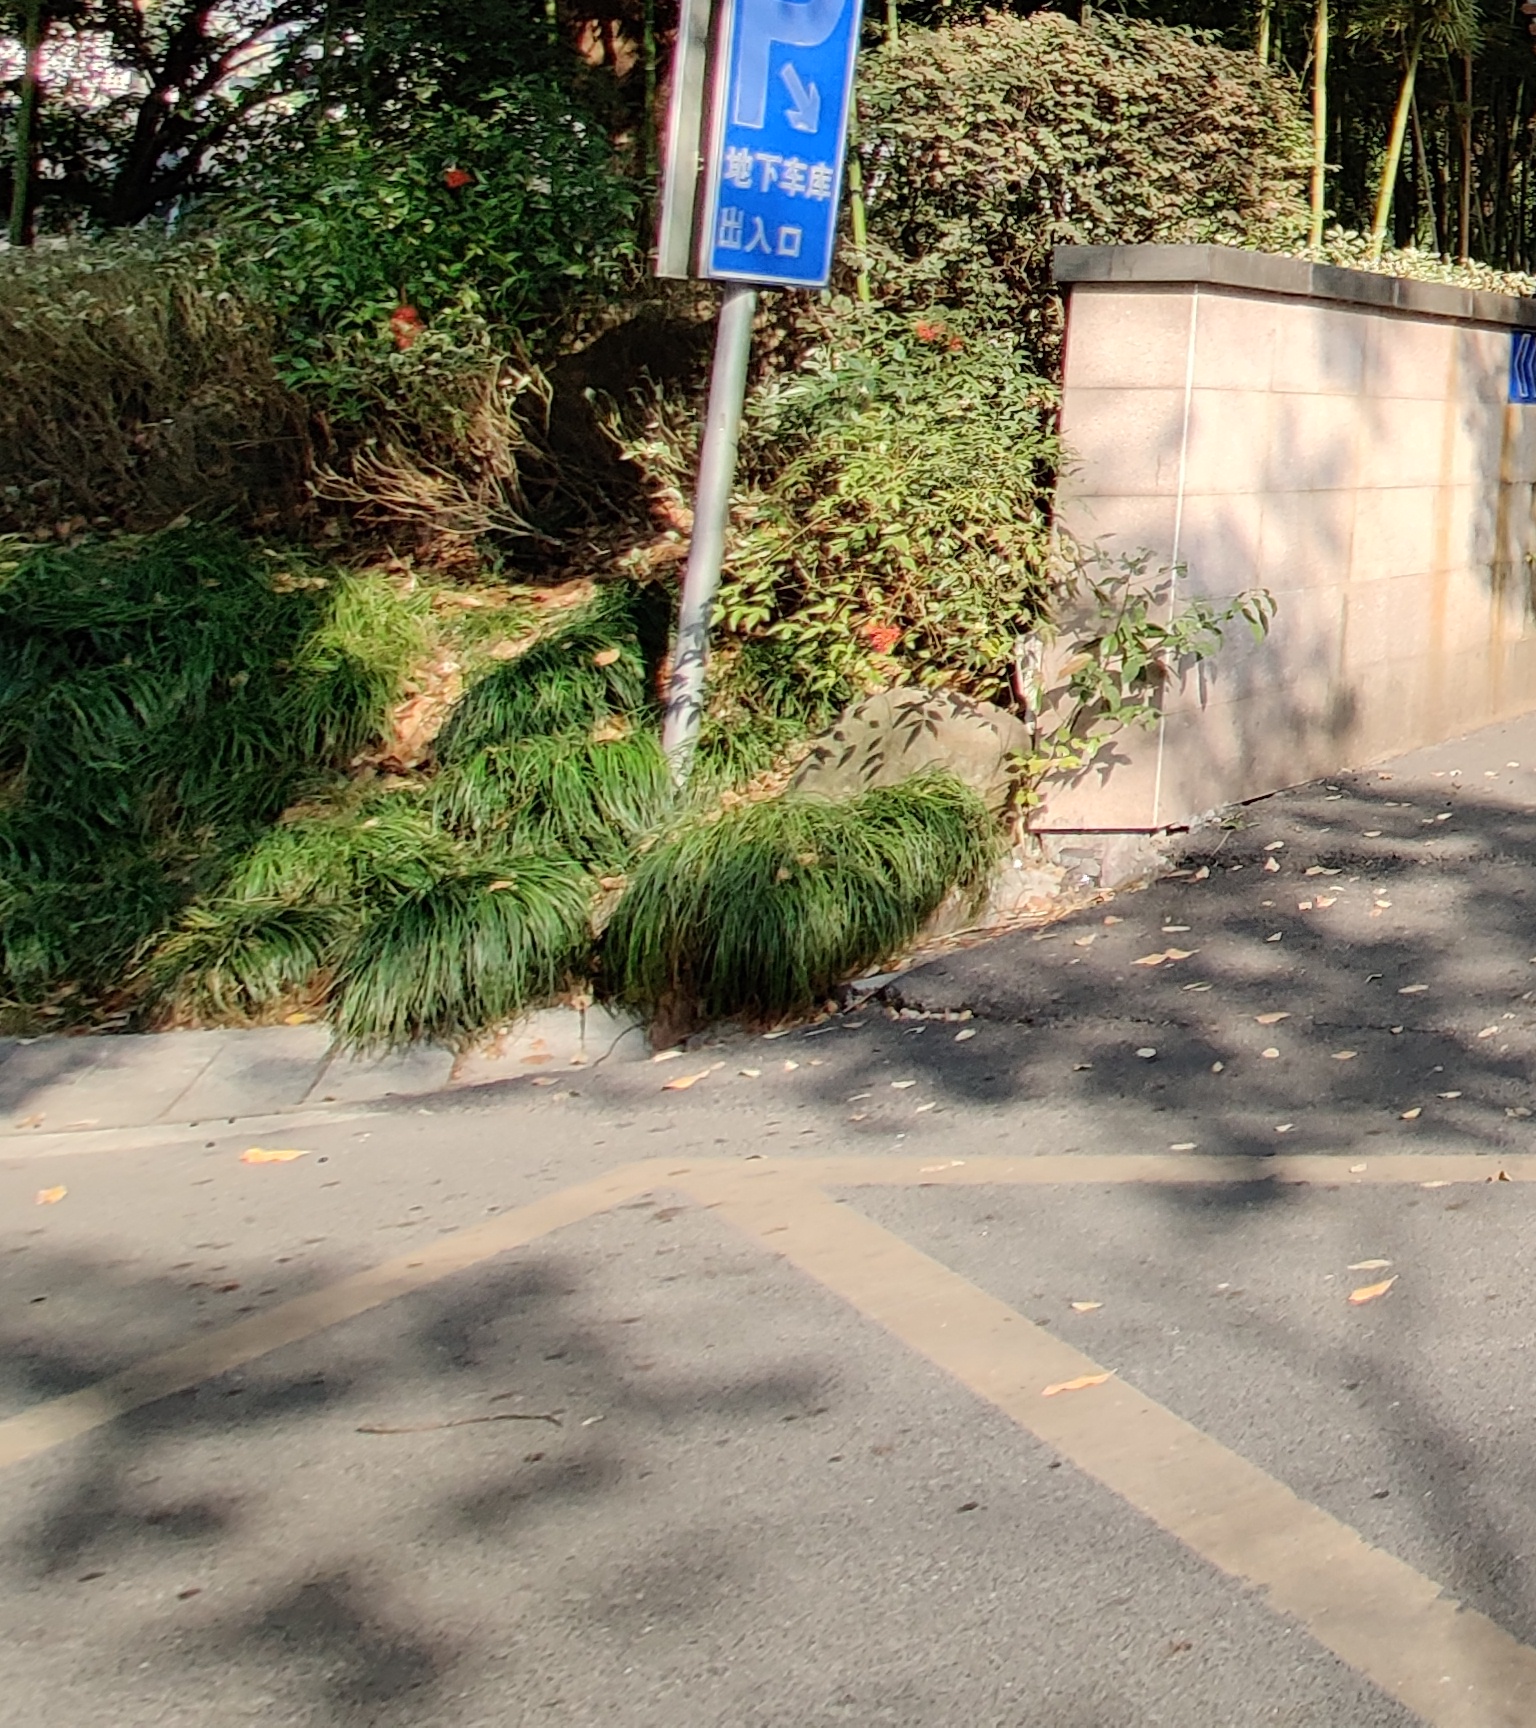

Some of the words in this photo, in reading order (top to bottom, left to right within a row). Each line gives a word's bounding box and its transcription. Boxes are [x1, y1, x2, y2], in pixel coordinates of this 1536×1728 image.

[724, 146, 834, 201] 地下车库
[719, 206, 803, 258] 出入口
